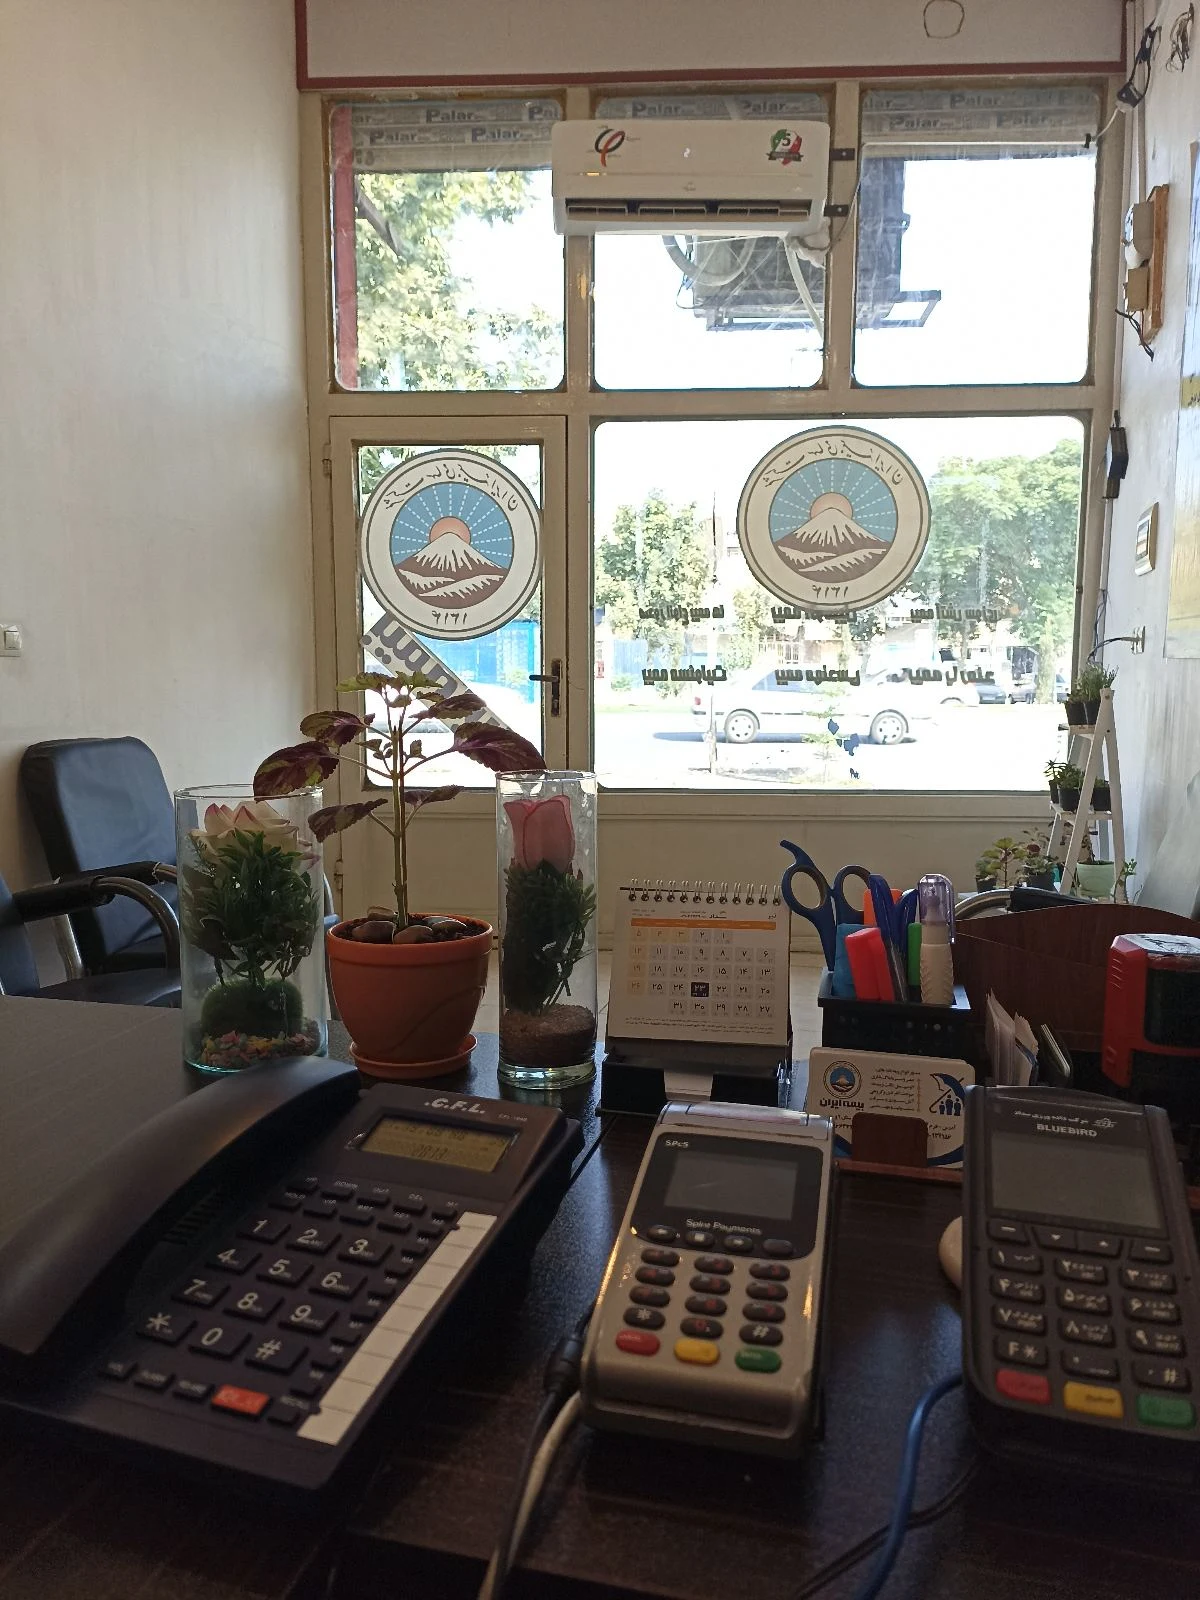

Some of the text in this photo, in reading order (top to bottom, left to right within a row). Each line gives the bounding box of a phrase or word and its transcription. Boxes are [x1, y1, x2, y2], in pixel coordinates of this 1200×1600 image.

[656, 947, 662, 956] ۱۱
[677, 948, 684, 956] ۱۰
[699, 948, 704, 956] ۹
[763, 950, 769, 958] ۶
[654, 965, 662, 973] ۱۸
[675, 965, 683, 973] ۱۷
[697, 966, 705, 974] ۱۶
[718, 967, 727, 975] ۱۵
[740, 968, 748, 976] ۱۴
[761, 968, 771, 976] ۱۳
[652, 982, 663, 990] ۲۵
[673, 983, 684, 991] ۲۴
[716, 985, 727, 993] ۲۲
[673, 1001, 770, 1013] ۲۷ ۲۸ ۲۹ ۳۰ ۳۱
[819, 1097, 842, 1109] ایران
[843, 1100, 865, 1111] بیمه
[1036, 1123, 1098, 1138] BLUEBIRD
[253, 1219, 269, 1234] 1
[712, 1221, 763, 1236] Payments
[297, 1228, 318, 1244] 2
[348, 1238, 369, 1254] 3
[217, 1248, 237, 1264] 4
[268, 1258, 291, 1276] 5
[320, 1271, 342, 1289] 6
[183, 1278, 208, 1295] 7
[237, 1291, 259, 1310] 8
[289, 1304, 312, 1322] 9
[1066, 1319, 1080, 1335] ۸
[201, 1327, 223, 1346] 0
[1135, 1329, 1148, 1345] ۹
